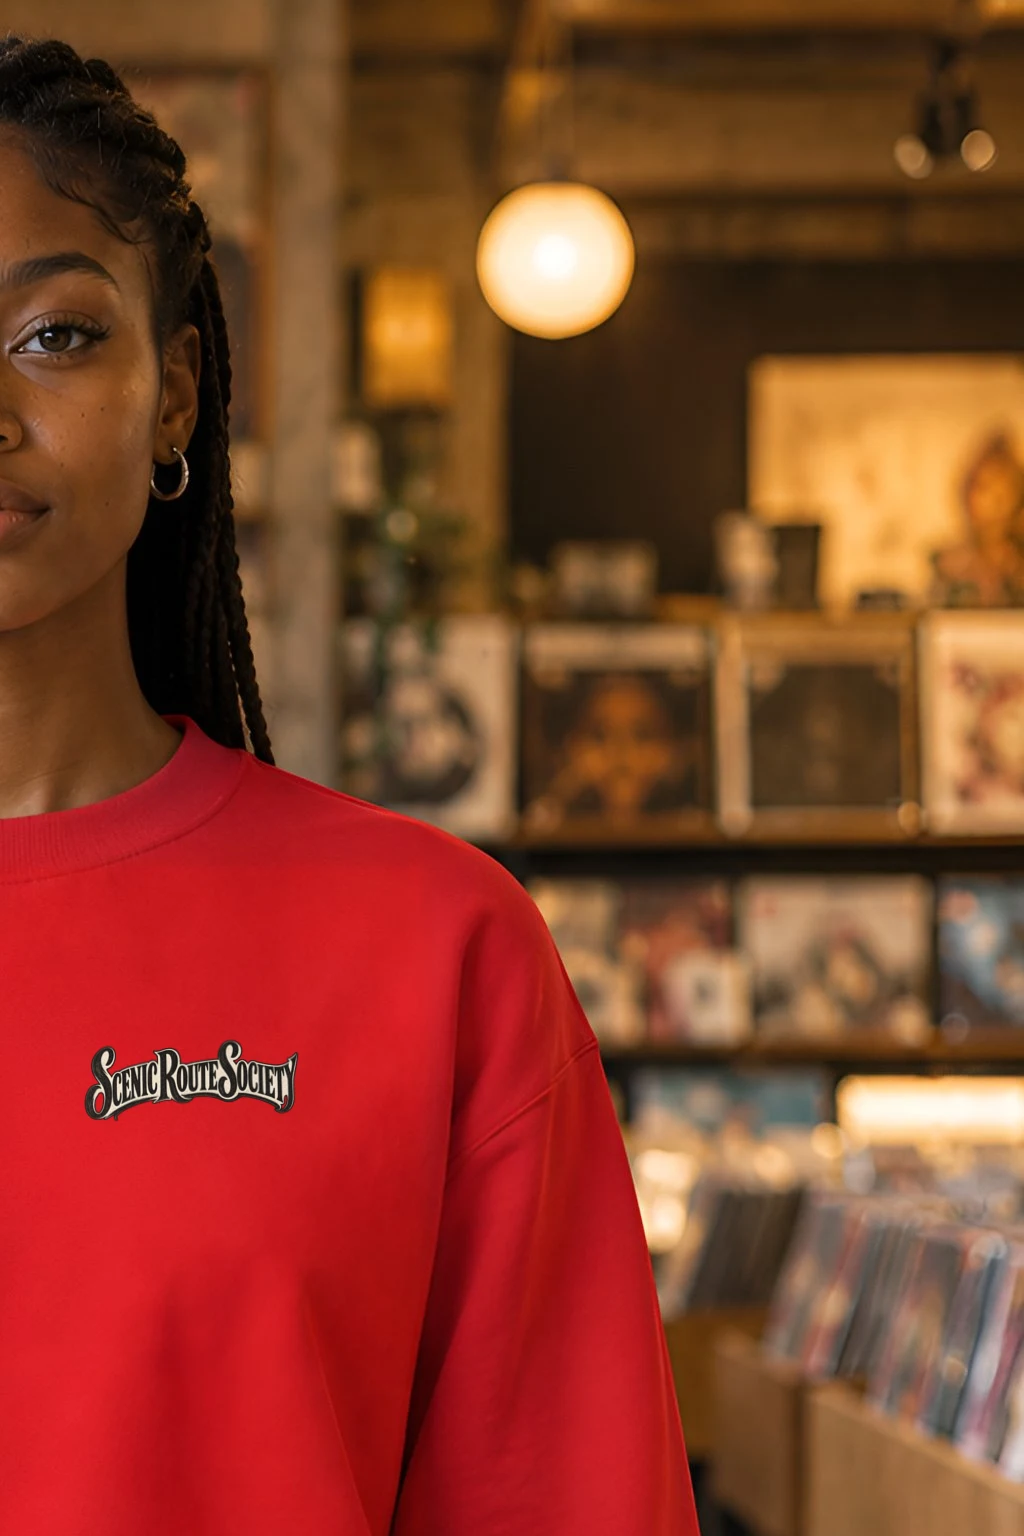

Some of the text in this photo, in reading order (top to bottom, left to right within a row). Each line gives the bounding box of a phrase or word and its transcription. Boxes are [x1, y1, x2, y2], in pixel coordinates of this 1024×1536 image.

[85, 1040, 298, 1119] SCENIC ROUTE SOCIETY
